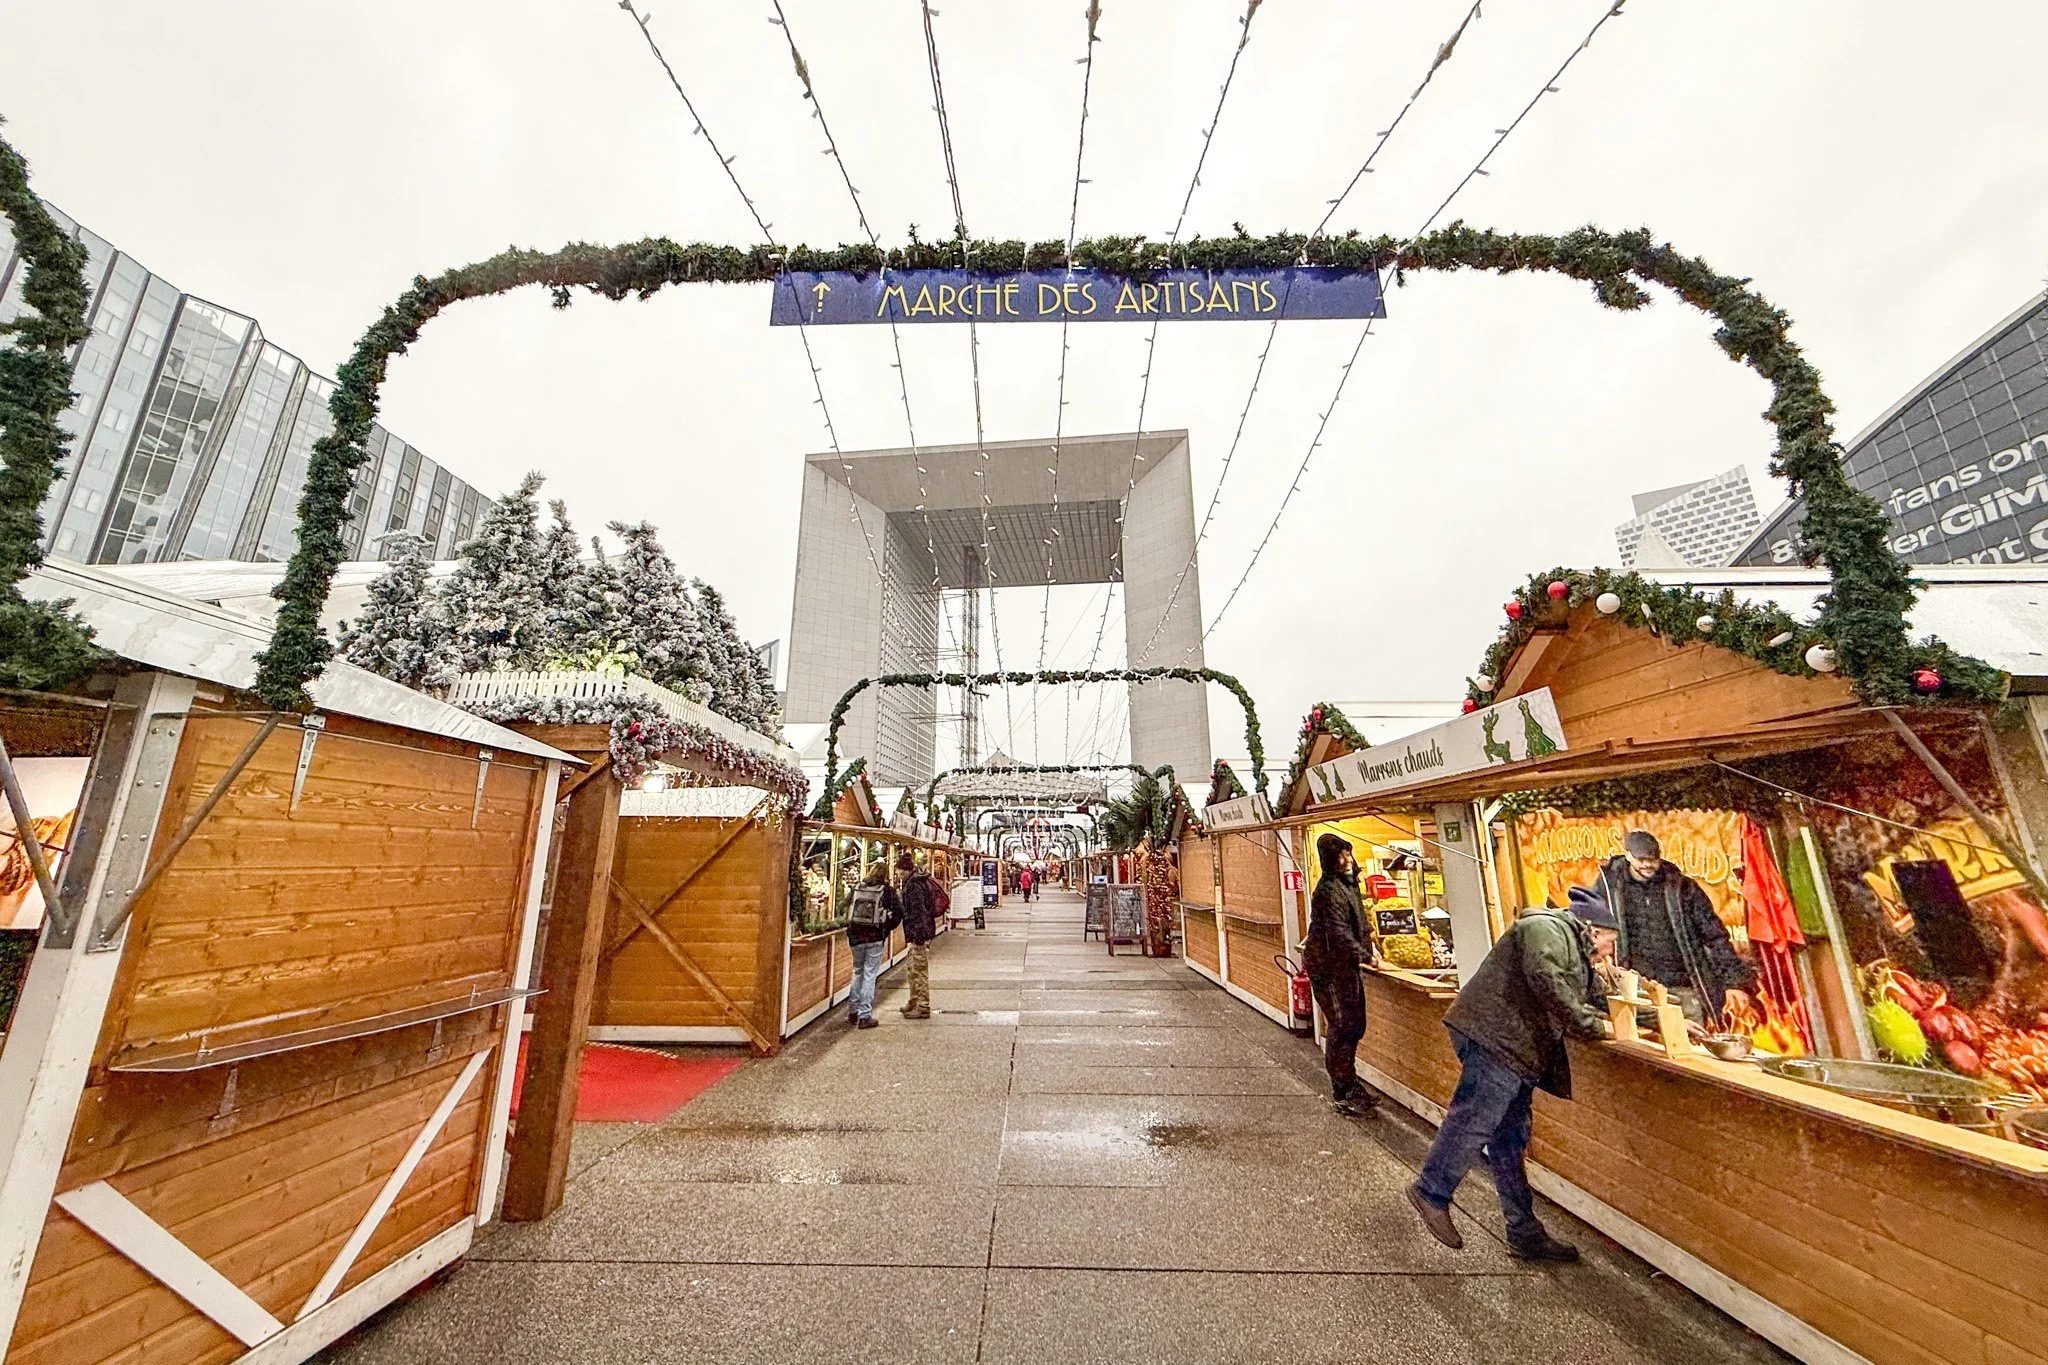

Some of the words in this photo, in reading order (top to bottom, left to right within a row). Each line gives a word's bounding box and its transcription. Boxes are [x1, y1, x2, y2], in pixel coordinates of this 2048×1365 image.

[877, 278, 1020, 317] MARCHÉ
[1037, 282, 1098, 316] DES
[1114, 280, 1278, 314] ARTISANS
[1887, 464, 1983, 516] fans
[1356, 757, 1404, 785] Marrons
[1403, 737, 1445, 774] chauds
[1532, 824, 1624, 865] MARRONS
